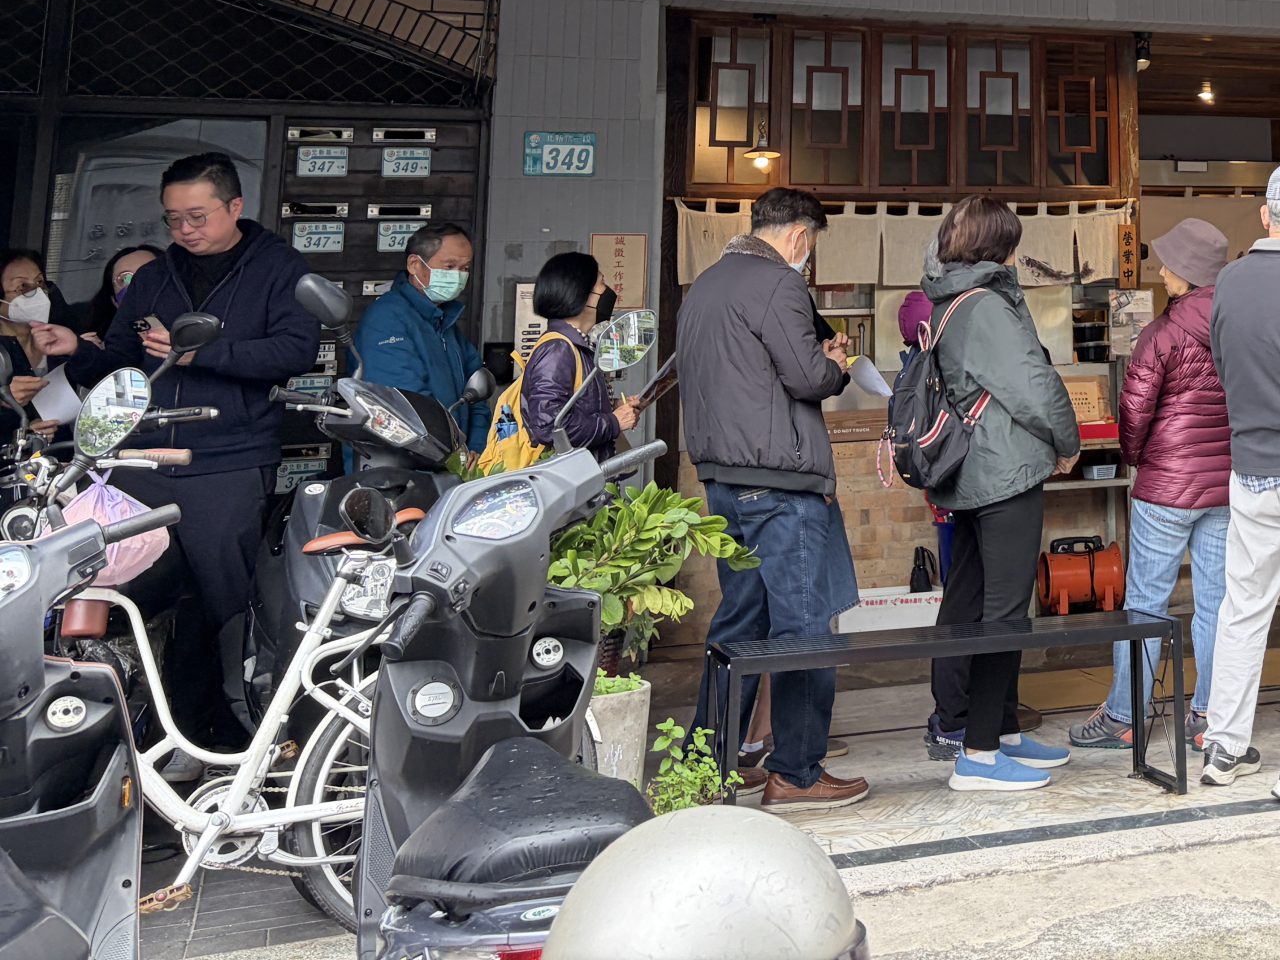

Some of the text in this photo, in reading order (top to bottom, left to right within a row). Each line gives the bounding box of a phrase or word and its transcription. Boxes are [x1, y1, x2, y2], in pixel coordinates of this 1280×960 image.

[545, 147, 591, 171] 349
[307, 160, 335, 173] 347
[392, 161, 419, 173] 349
[303, 236, 332, 248] 347
[388, 236, 407, 248] 34
[1122, 230, 1134, 283] 營業中
[285, 475, 302, 489] 34
[936, 735, 963, 747] MERREL
